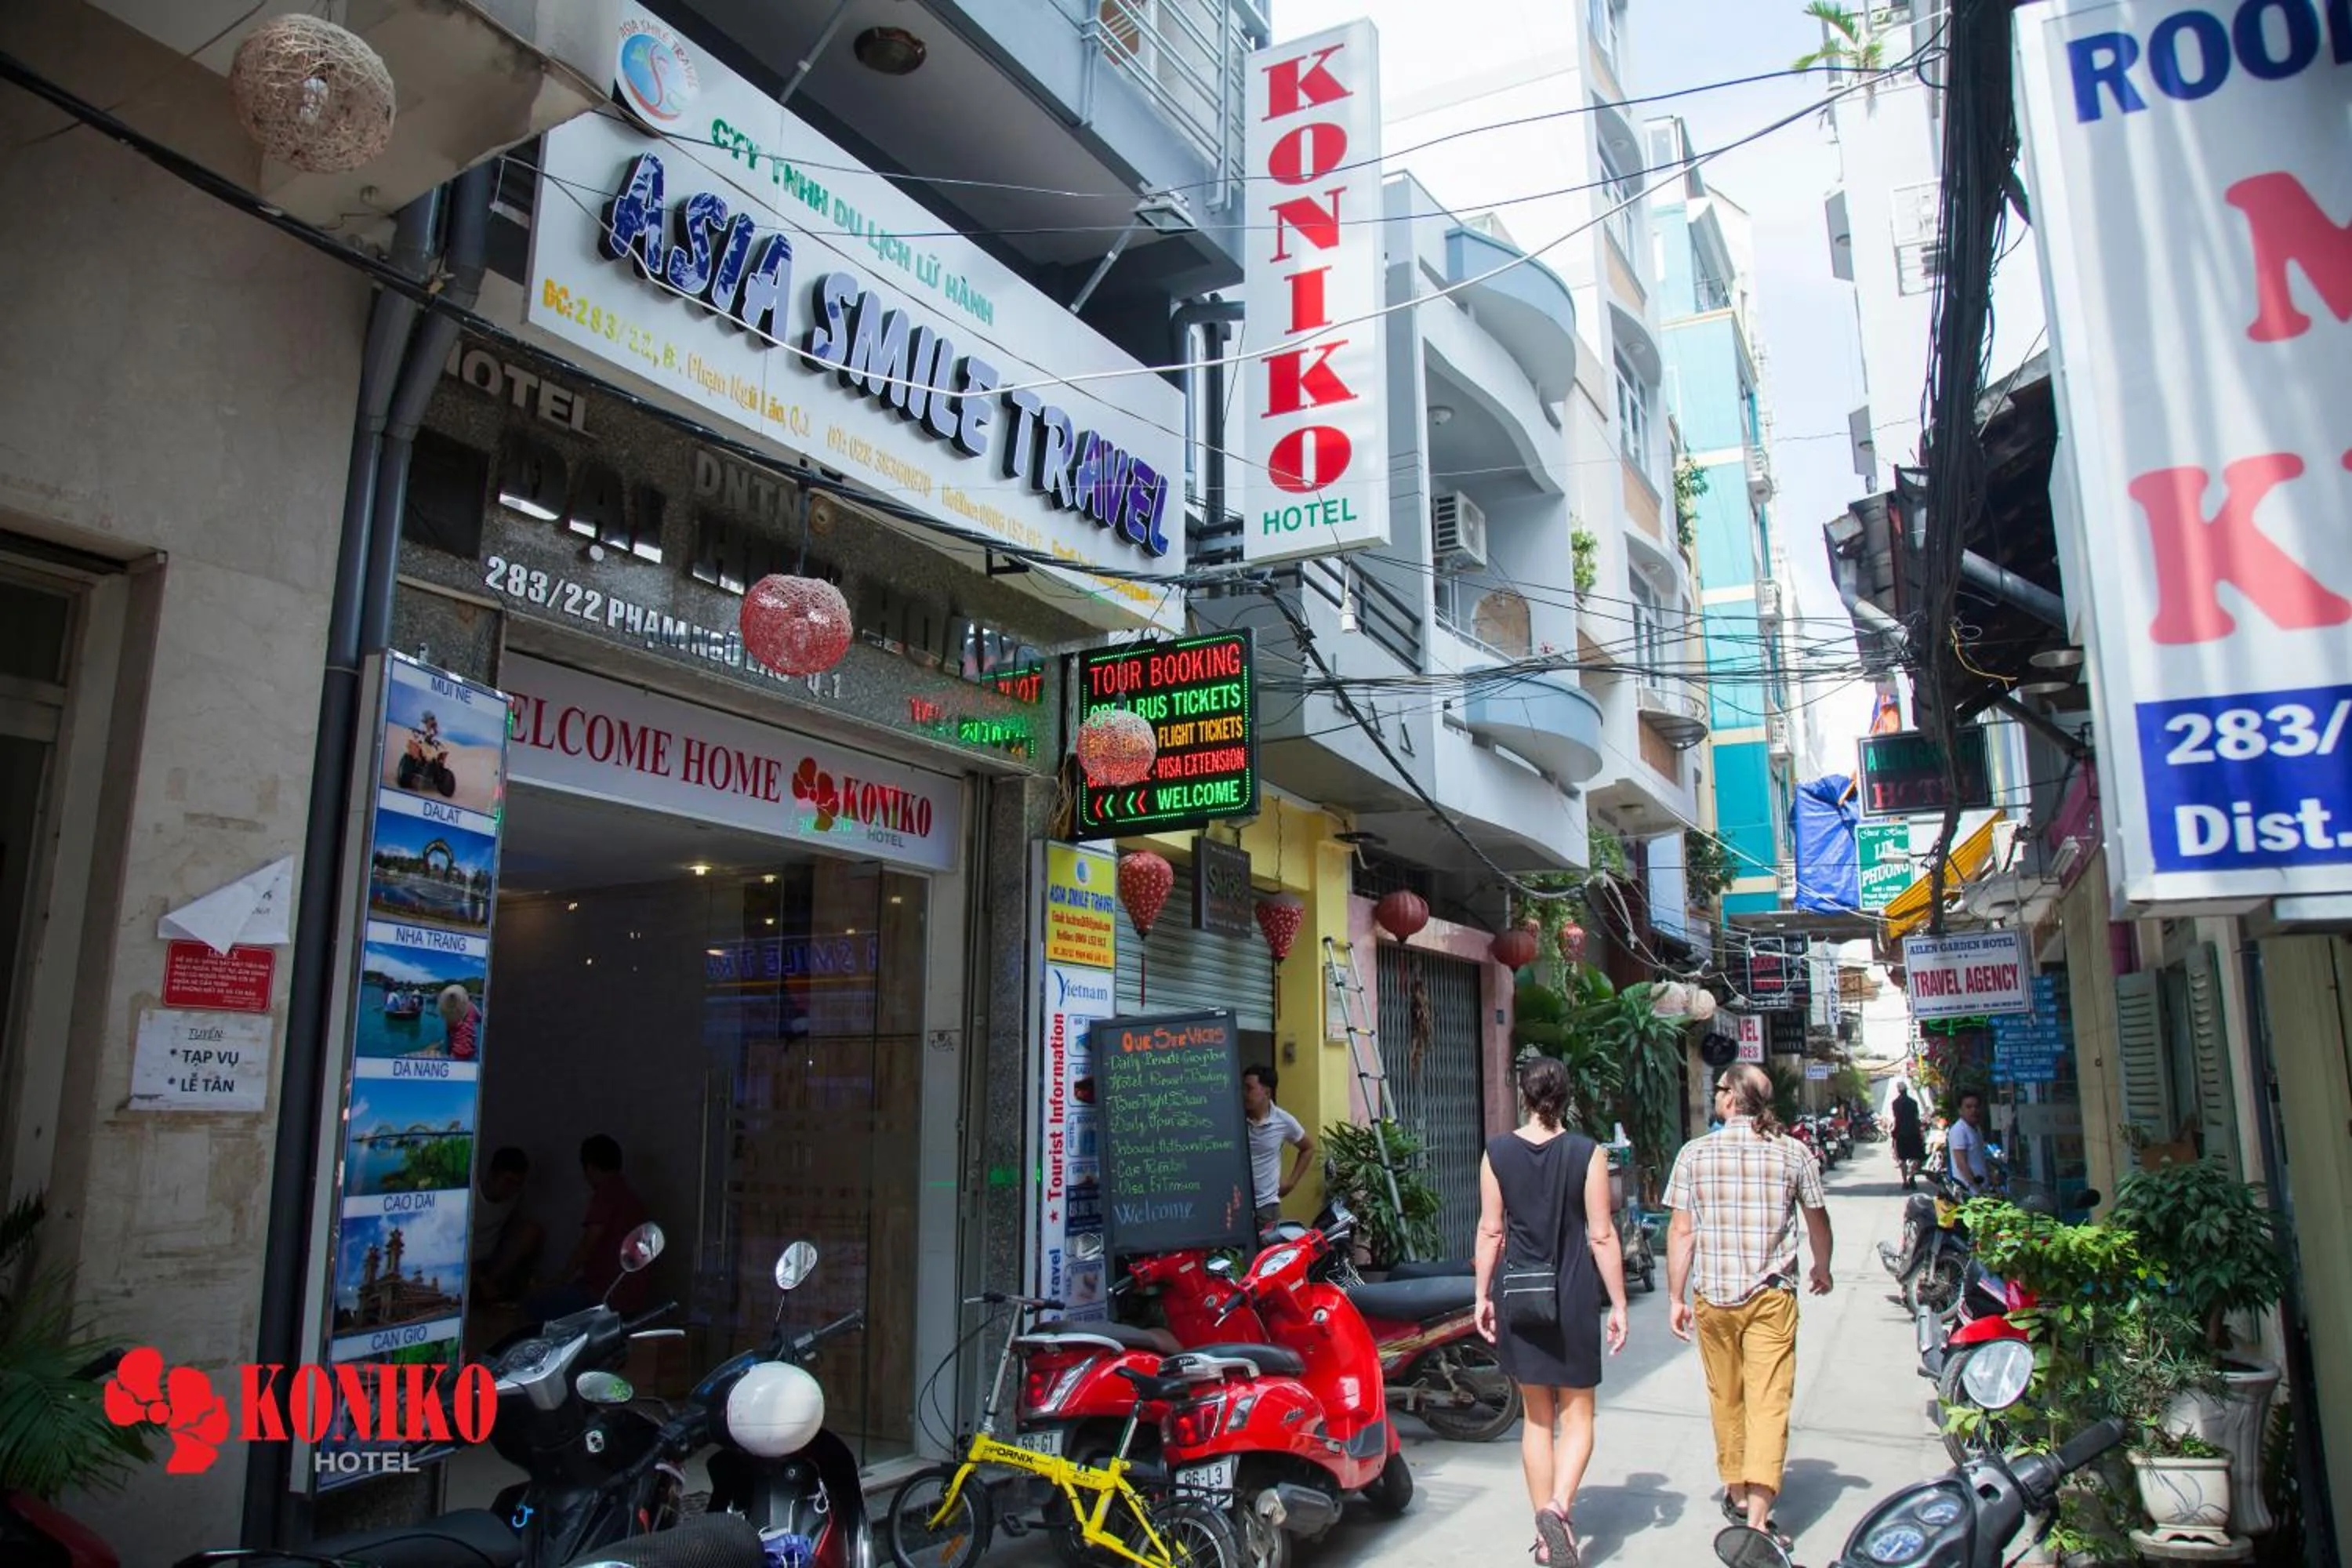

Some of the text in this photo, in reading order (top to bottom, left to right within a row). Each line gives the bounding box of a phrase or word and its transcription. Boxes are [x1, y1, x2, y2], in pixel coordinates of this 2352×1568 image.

[2066, 0, 2352, 124] ROO
[772, 158, 828, 216] TNHH
[833, 197, 862, 238] DU
[1261, 43, 1358, 494] KONIKO
[608, 151, 793, 347] ASIA
[804, 271, 1000, 457] SMILE
[1003, 383, 1170, 558] TRAVEL
[1263, 495, 1357, 535] HOTEL
[485, 555, 602, 623] 283/22
[608, 597, 687, 650] PHẠM
[1090, 660, 1142, 697] TOUR
[1150, 642, 1240, 687] BOOKING
[430, 676, 473, 705] MUI NE
[1136, 695, 1167, 719] BUS
[1172, 683, 1241, 717] TICKETS
[508, 692, 782, 804] ELCOME HOME
[1158, 722, 1197, 749] FLIGHT
[1199, 715, 1243, 744] TICKETS
[1156, 747, 1246, 779] VISA EXTENSION
[842, 775, 931, 838] KONIKO
[1156, 779, 1240, 811] WELCOME
[423, 800, 462, 826] DALAT
[867, 829, 905, 848] HOTEL
[395, 926, 467, 952] NHA TRANG
[1940, 940, 1980, 953] GARDEN
[1982, 936, 2016, 949] HOTEL
[1054, 968, 1108, 1008] Vietnam
[1912, 963, 2019, 997] TRAVEL AGENCY
[182, 1049, 239, 1067] TẠP VỤ
[392, 1061, 450, 1079] DA NANG
[202, 1075, 234, 1092] TÂN
[1047, 1013, 1065, 1202] Tourist Information
[383, 1190, 436, 1212] CAO DAI
[371, 1325, 427, 1351] CAN GIO
